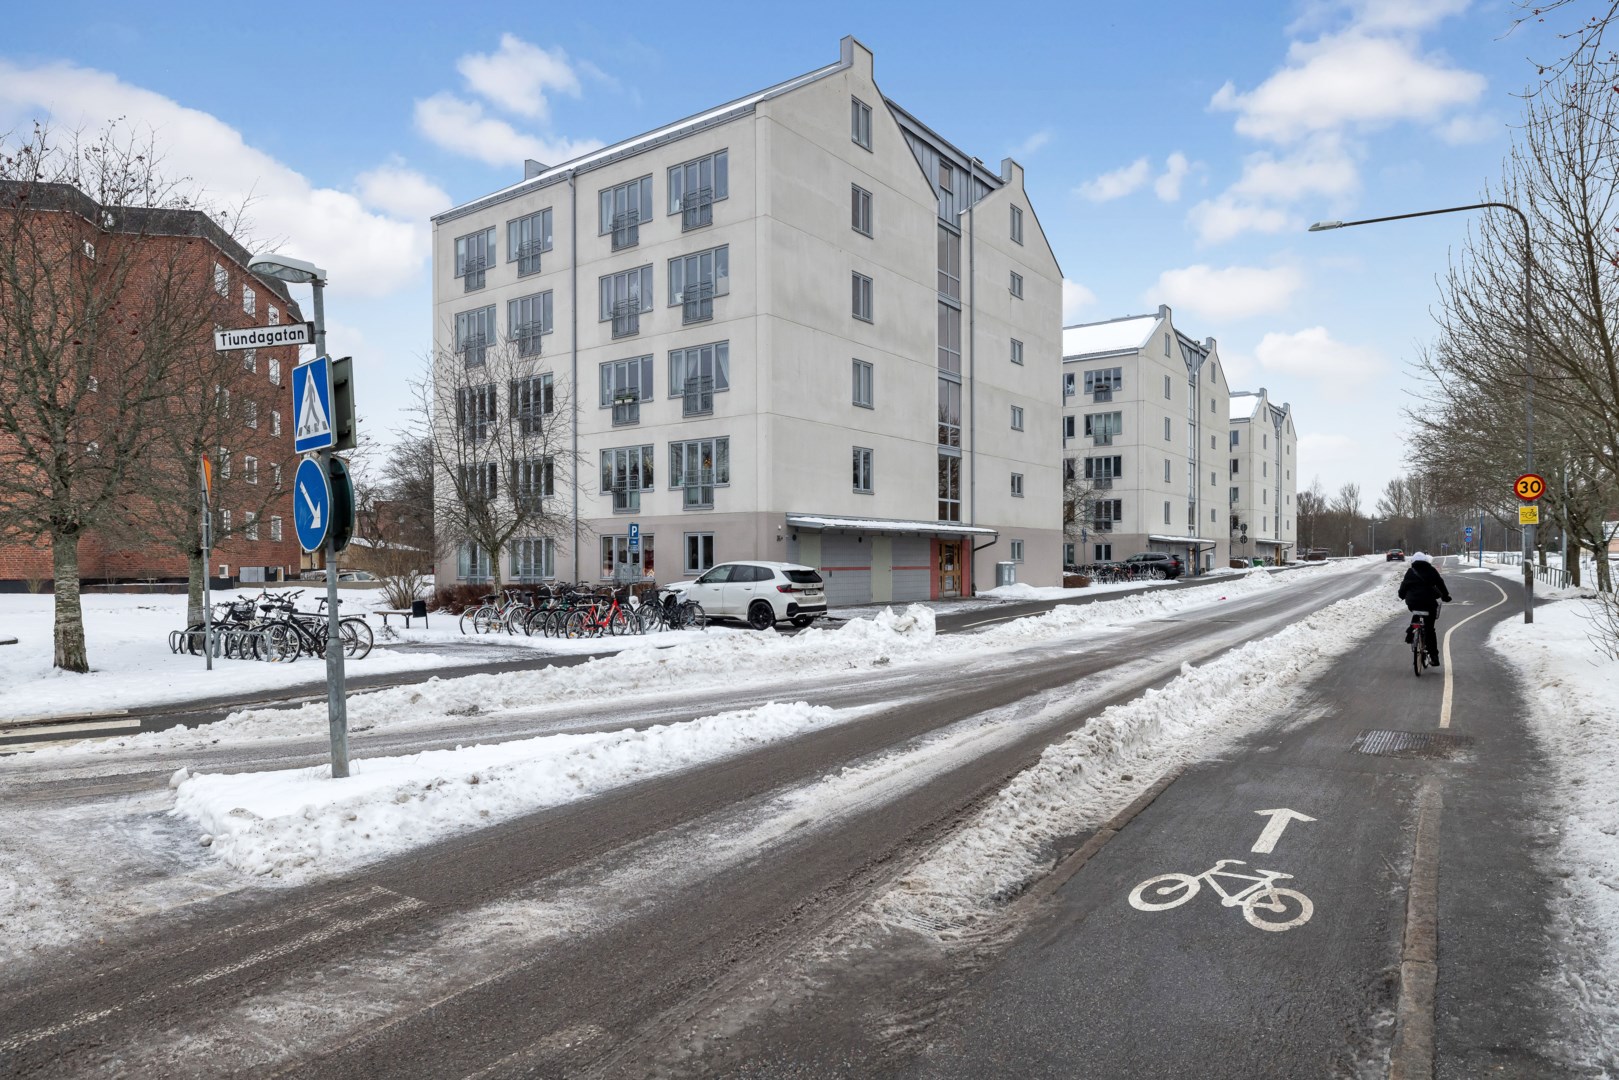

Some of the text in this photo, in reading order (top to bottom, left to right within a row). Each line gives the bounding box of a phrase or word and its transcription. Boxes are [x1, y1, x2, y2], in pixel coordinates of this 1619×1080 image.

[220, 329, 304, 346] Tiundagatan
[1520, 480, 1541, 493] 30
[631, 525, 638, 537] P
